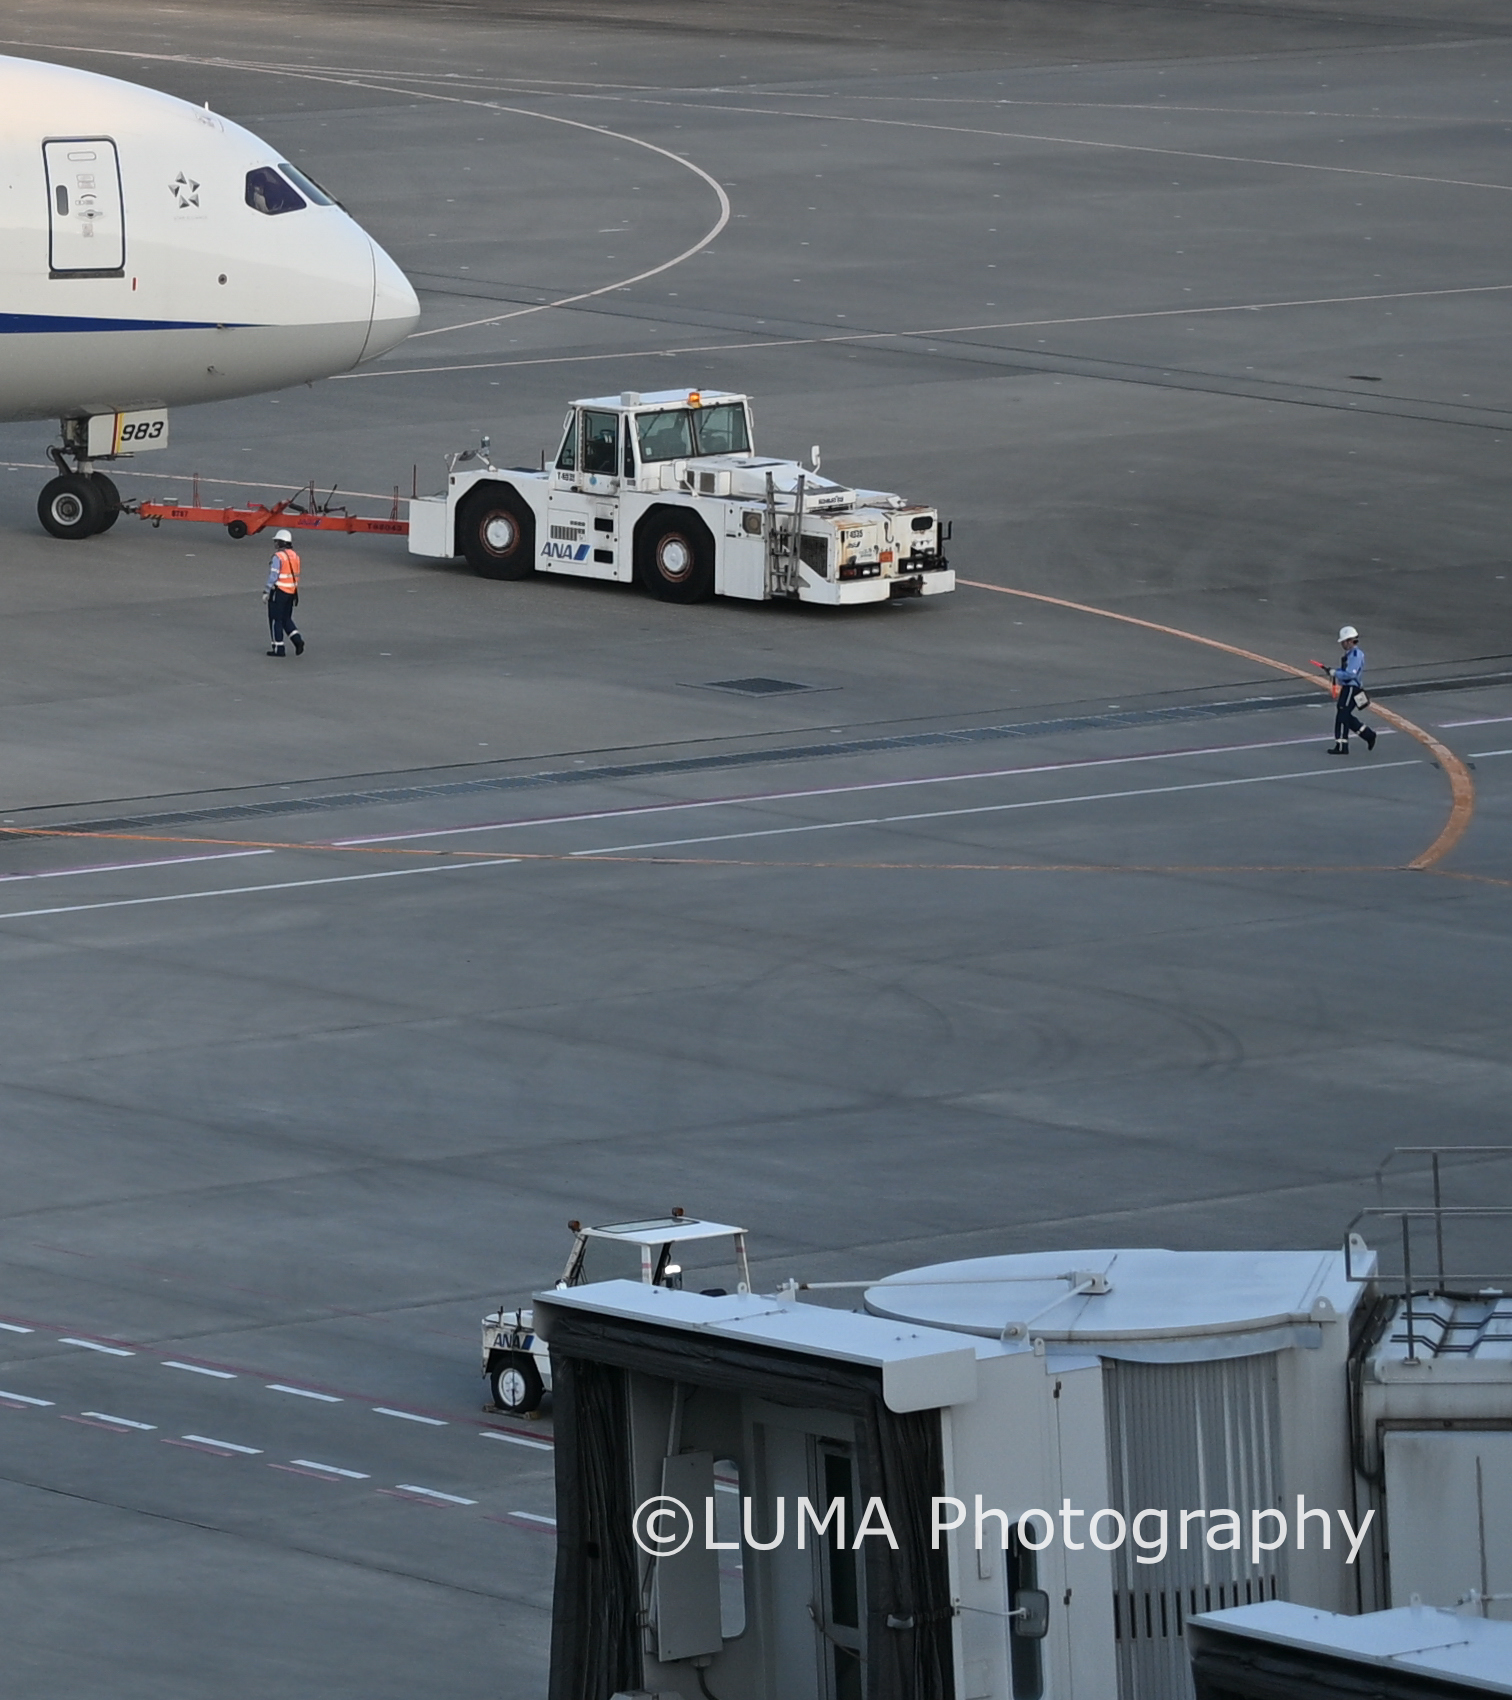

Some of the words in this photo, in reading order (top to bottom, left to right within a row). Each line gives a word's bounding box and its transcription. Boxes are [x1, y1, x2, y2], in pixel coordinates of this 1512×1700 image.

[119, 420, 164, 442] 983
[540, 541, 573, 560] ANA
[493, 1332, 521, 1349] ANA
